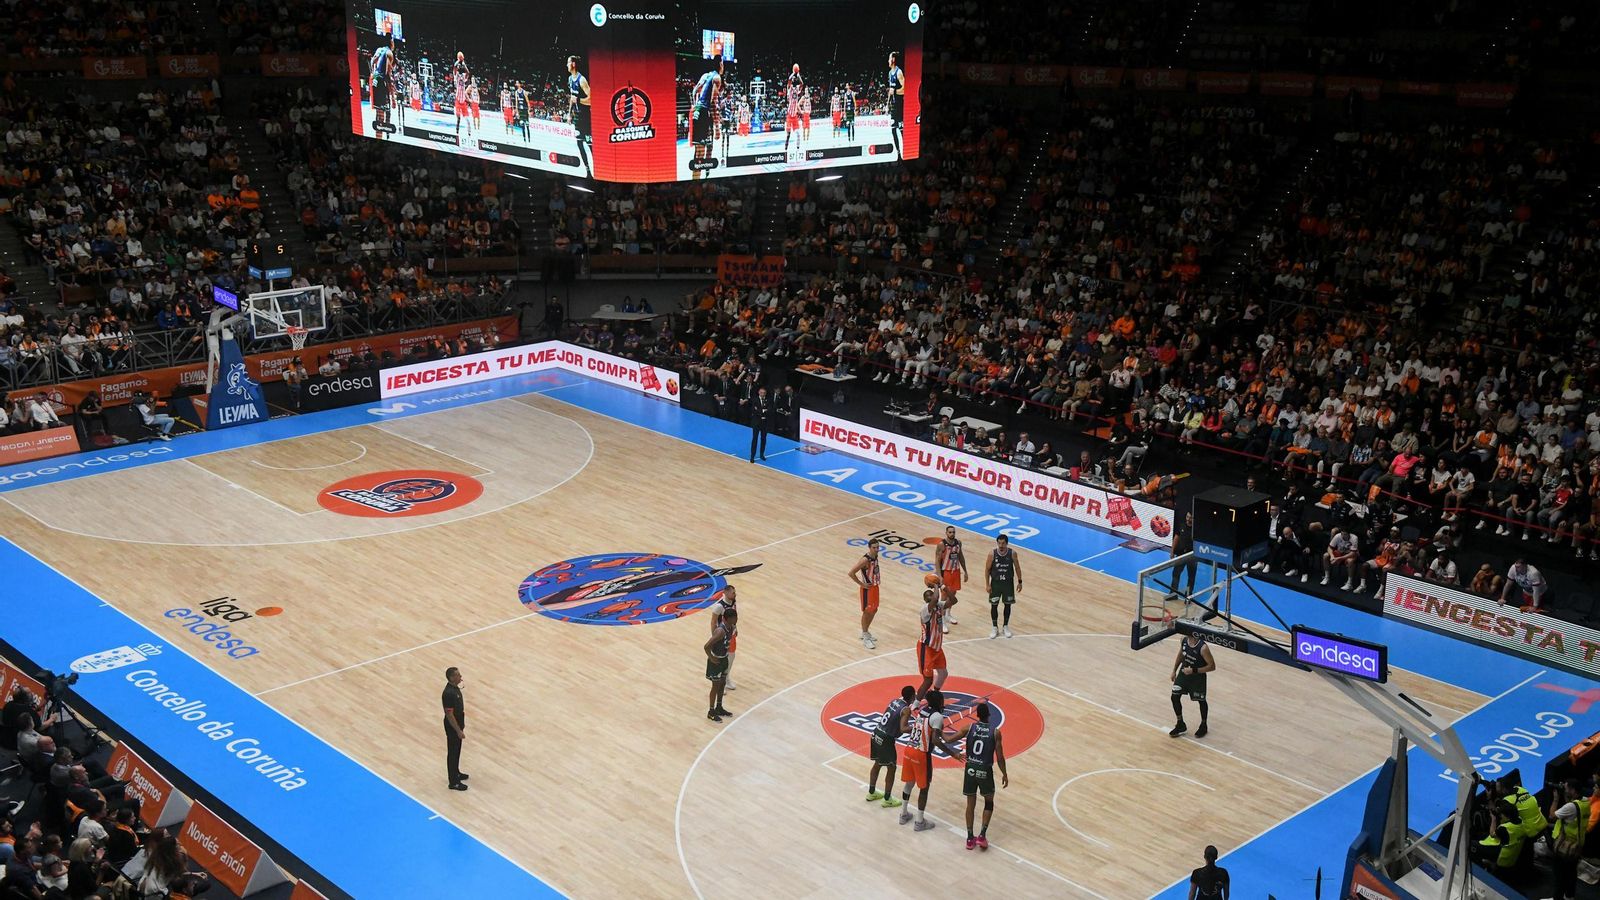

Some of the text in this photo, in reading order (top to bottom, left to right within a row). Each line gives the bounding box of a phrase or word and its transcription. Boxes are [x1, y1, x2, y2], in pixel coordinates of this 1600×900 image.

[608, 12, 634, 20] Concello
[214, 290, 238, 306] endesa
[180, 370, 208, 384] LEYMA
[497, 354, 523, 370] TU
[528, 349, 583, 367] MEJOR
[588, 358, 637, 383] COMPR
[100, 379, 148, 393] Fagamos
[308, 376, 373, 396] endesa
[218, 403, 260, 425] LEYMA
[905, 446, 932, 467] TU
[936, 456, 1012, 490] MEJOR
[1019, 480, 1102, 517] COMPR
[807, 467, 1041, 540] A Coruña
[868, 529, 925, 550] liga
[199, 596, 253, 623] liga
[164, 608, 260, 659] endesa
[1192, 631, 1237, 649] endesa
[1300, 642, 1376, 672] endesa
[881, 712, 891, 725] 6
[125, 669, 308, 791] Concello da Coruña
[973, 740, 984, 755] 0
[130, 767, 163, 803] Fagamos
[187, 821, 246, 877] Nordés ancín
